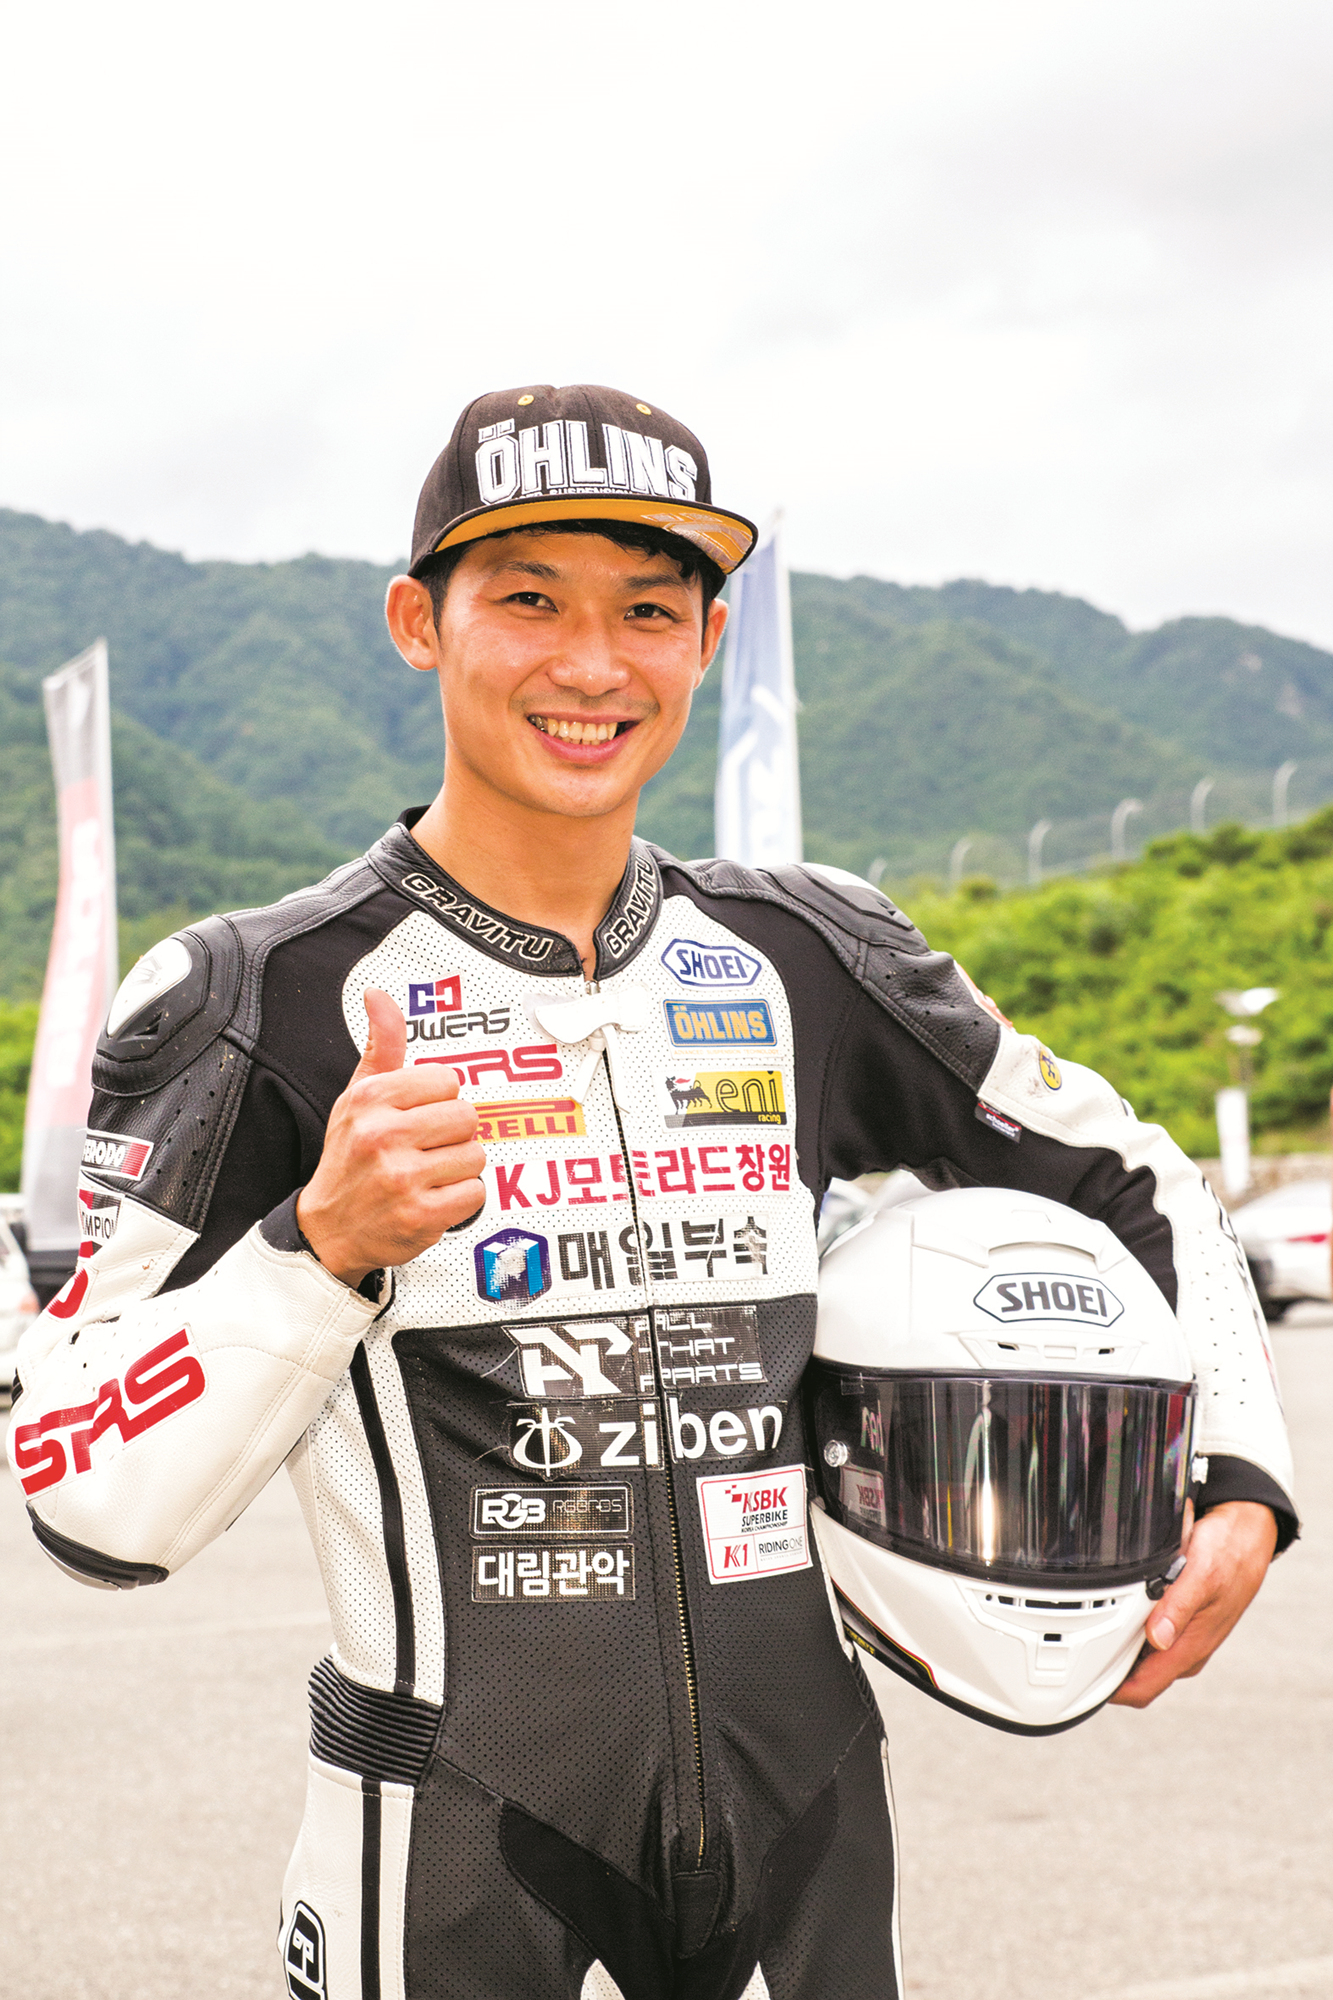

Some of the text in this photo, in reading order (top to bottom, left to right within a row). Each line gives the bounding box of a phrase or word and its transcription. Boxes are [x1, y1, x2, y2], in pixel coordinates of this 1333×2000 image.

[475, 418, 698, 504] ÖHLINS
[401, 873, 554, 961] GRAVITU
[603, 855, 658, 959] GRAVITU
[676, 949, 748, 979] SHOEI
[673, 1005, 768, 1040] ÖHLINS
[716, 1070, 779, 1112] eni
[473, 1114, 577, 1141] RELLI
[758, 1113, 781, 1125] racing
[996, 1281, 1107, 1318] SHOEI
[599, 1397, 783, 1467] ziben
[741, 1509, 788, 1527] SUPERBIKE
[742, 1486, 789, 1514] KSBK
[478, 1550, 629, 1597] 대림관악
[723, 1543, 748, 1569] K1
